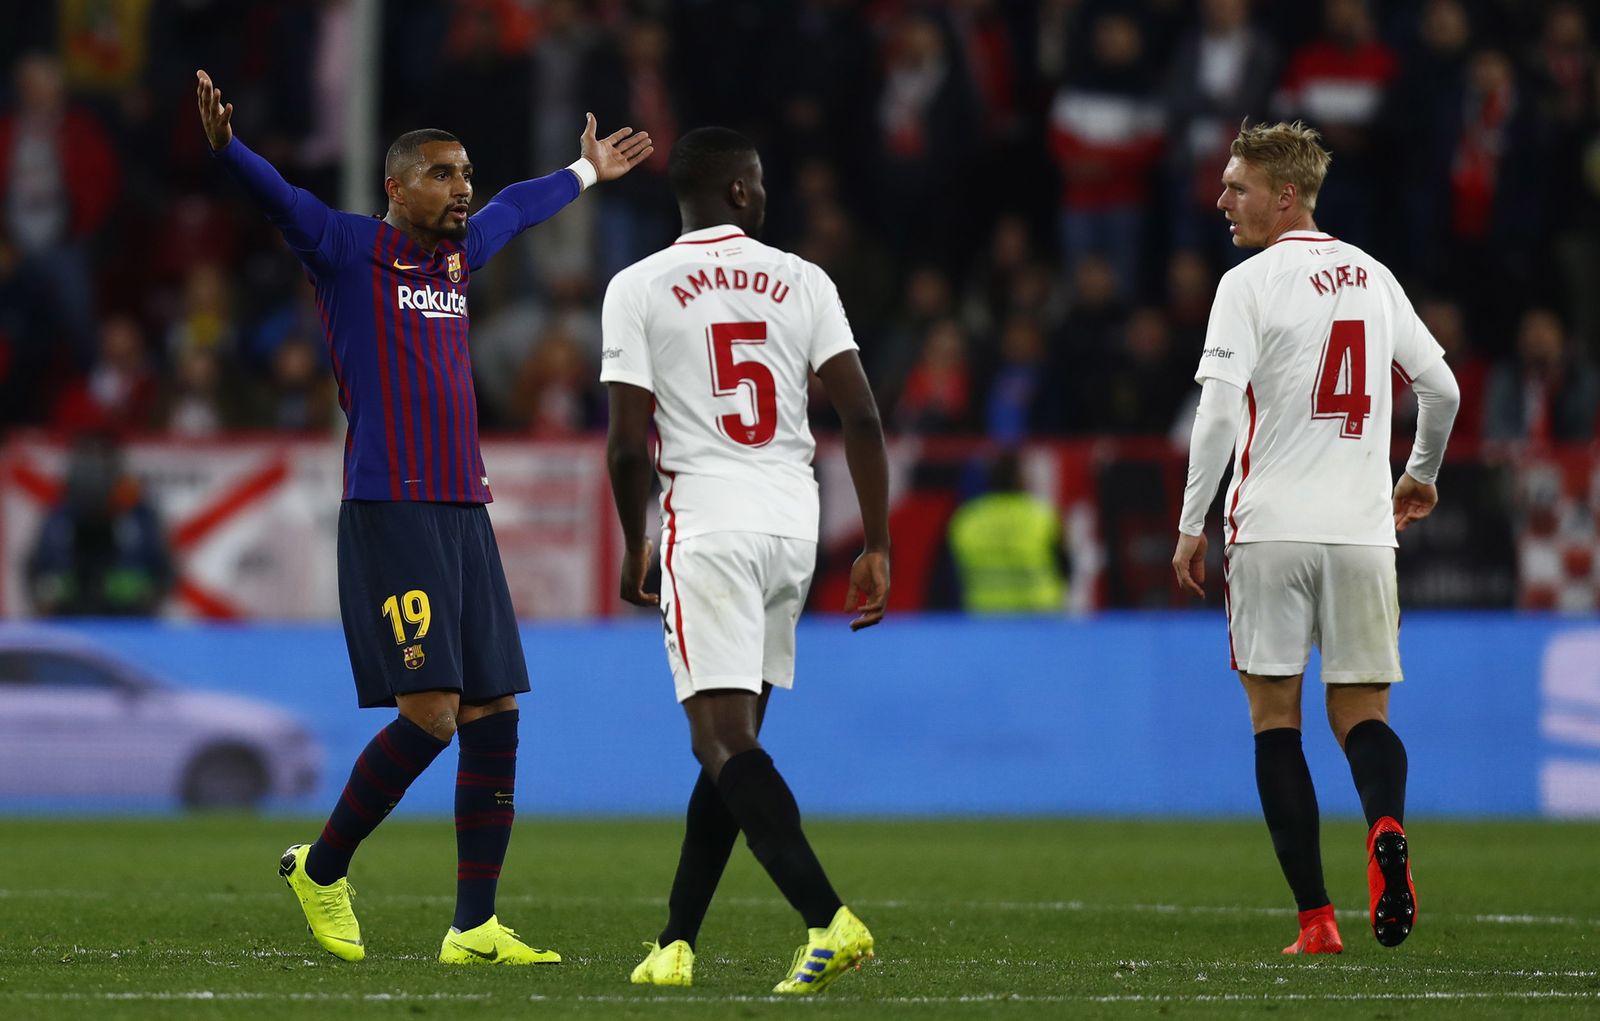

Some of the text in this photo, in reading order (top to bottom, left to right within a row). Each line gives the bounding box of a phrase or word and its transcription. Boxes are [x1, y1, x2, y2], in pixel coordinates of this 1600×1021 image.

[671, 266, 790, 309] AMADOU
[1309, 264, 1368, 297] KJÆR
[705, 321, 777, 449] 5
[1311, 320, 1371, 440] 4
[381, 589, 431, 646] 19
